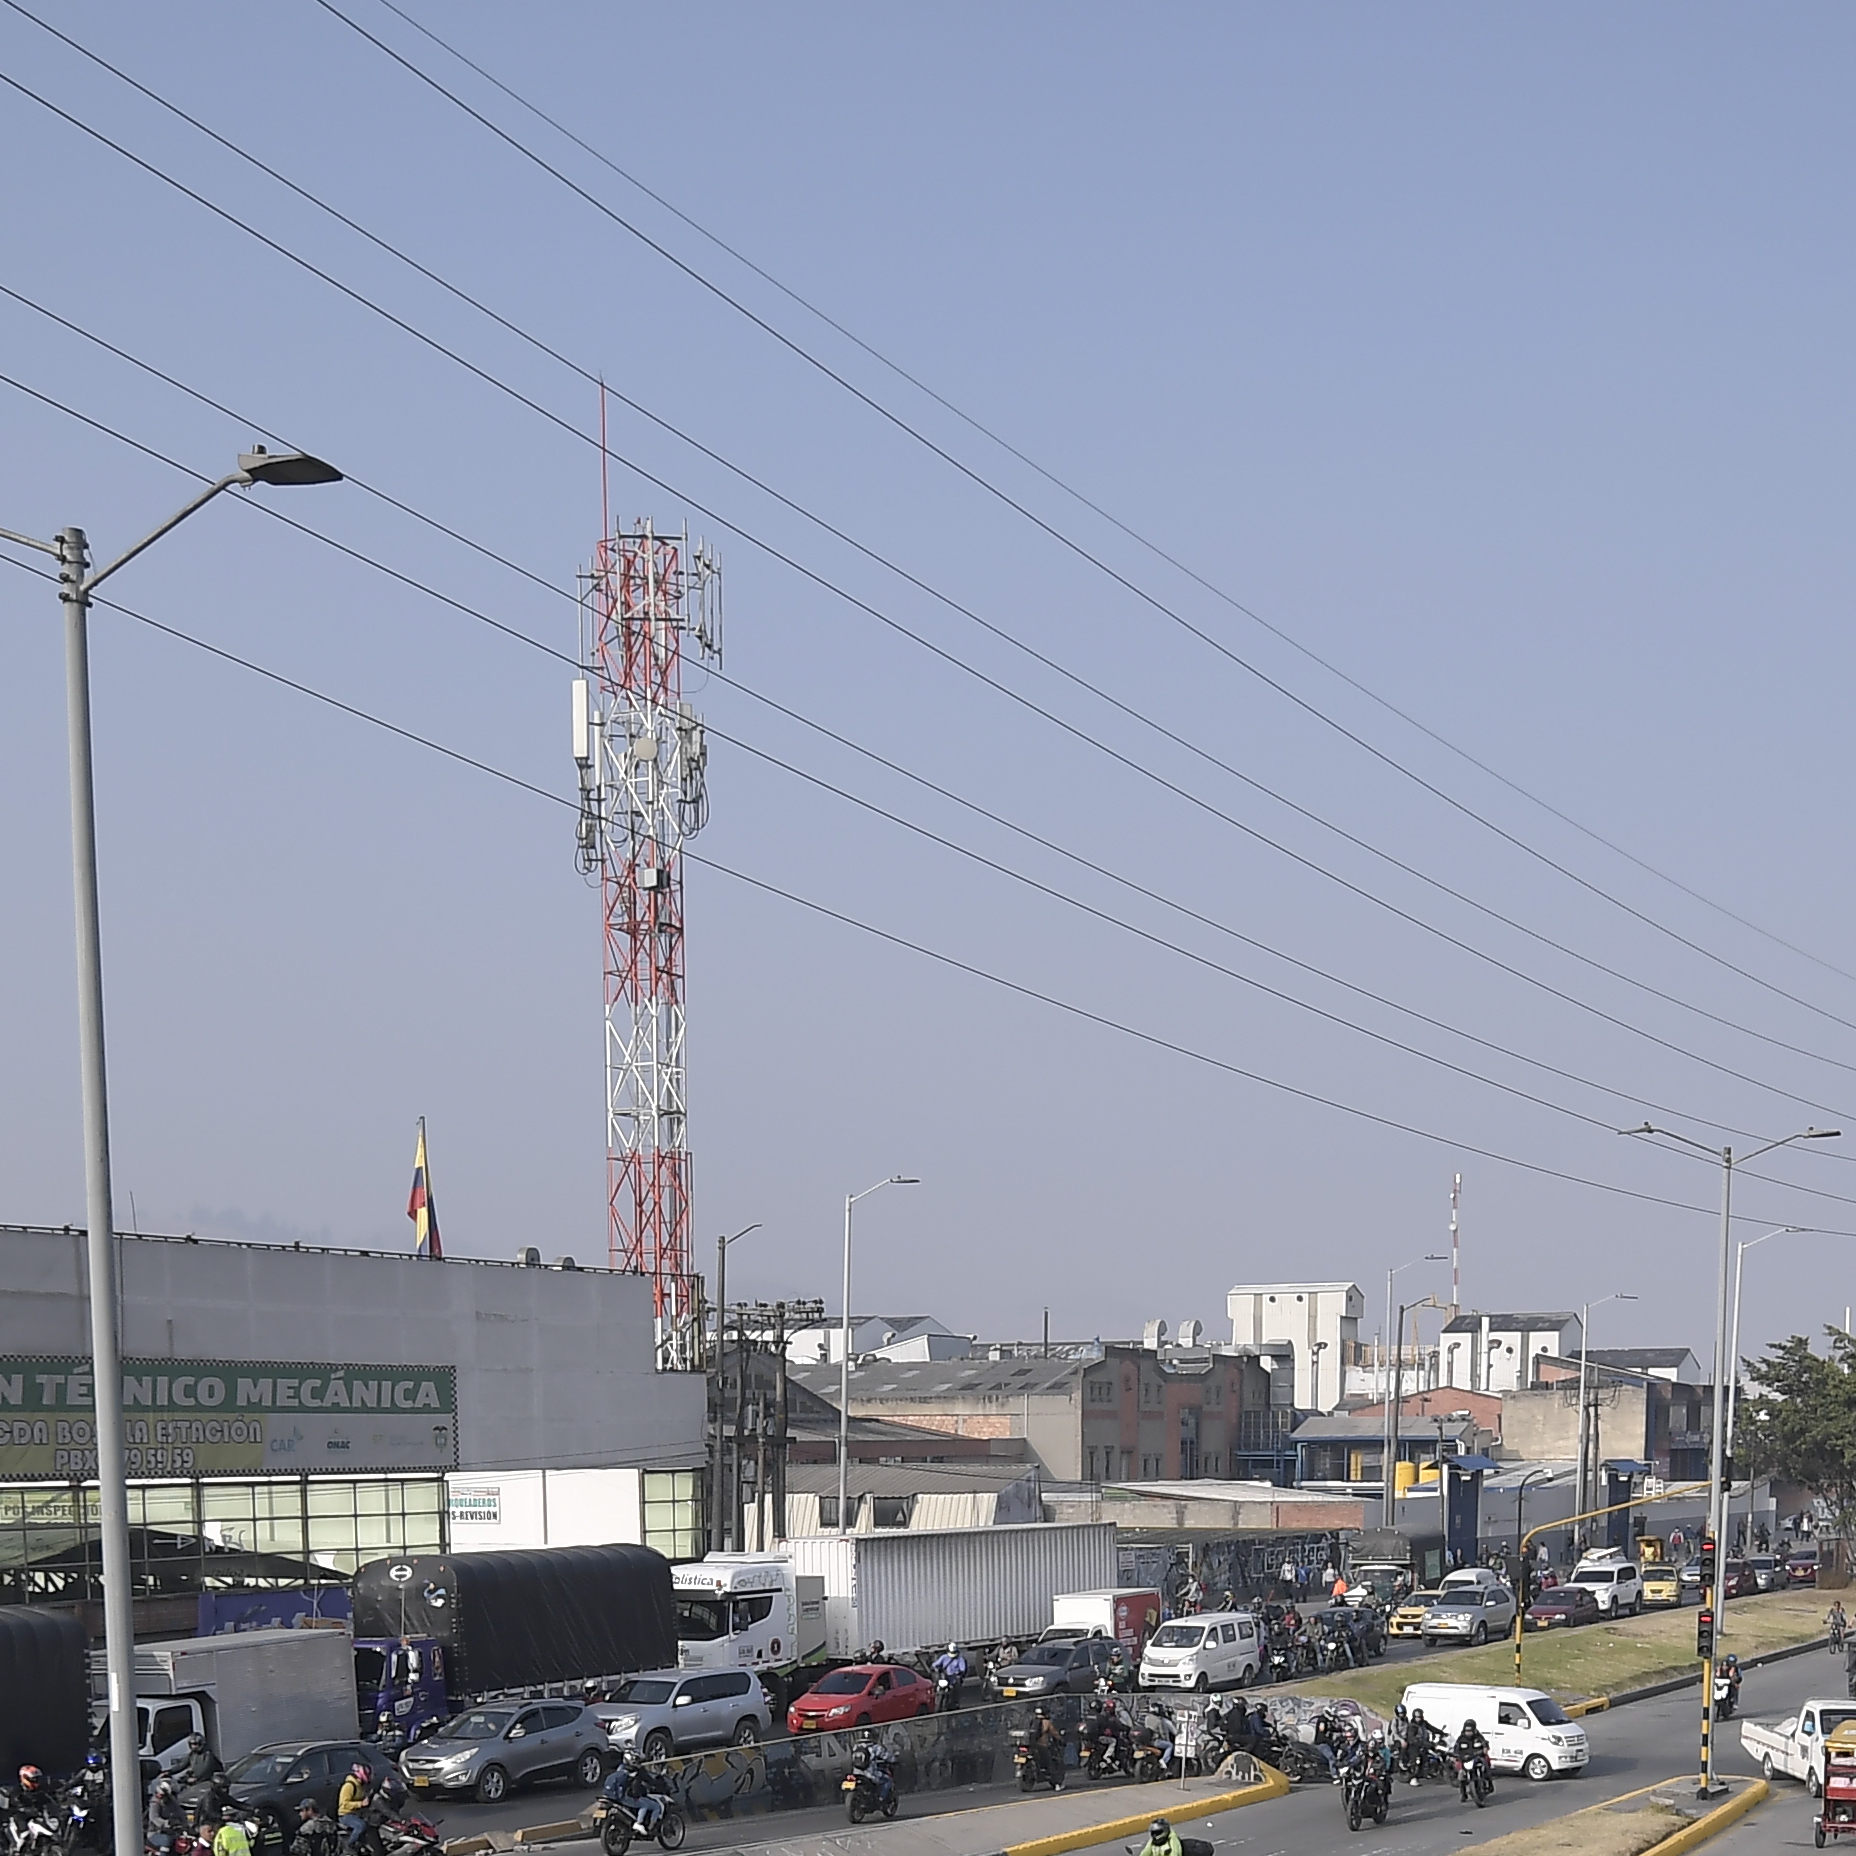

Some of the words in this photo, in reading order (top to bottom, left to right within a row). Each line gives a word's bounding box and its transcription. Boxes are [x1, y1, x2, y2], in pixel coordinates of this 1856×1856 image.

[36, 1363, 226, 1407] TÉNICO
[236, 1369, 441, 1409] MECÁNICA
[55, 1419, 98, 1446] BO
[125, 1420, 149, 1445] LA
[155, 1414, 263, 1445] ESTACIÓN
[54, 1448, 100, 1472] PBX
[146, 1448, 169, 1471] 59
[171, 1447, 194, 1470] 59
